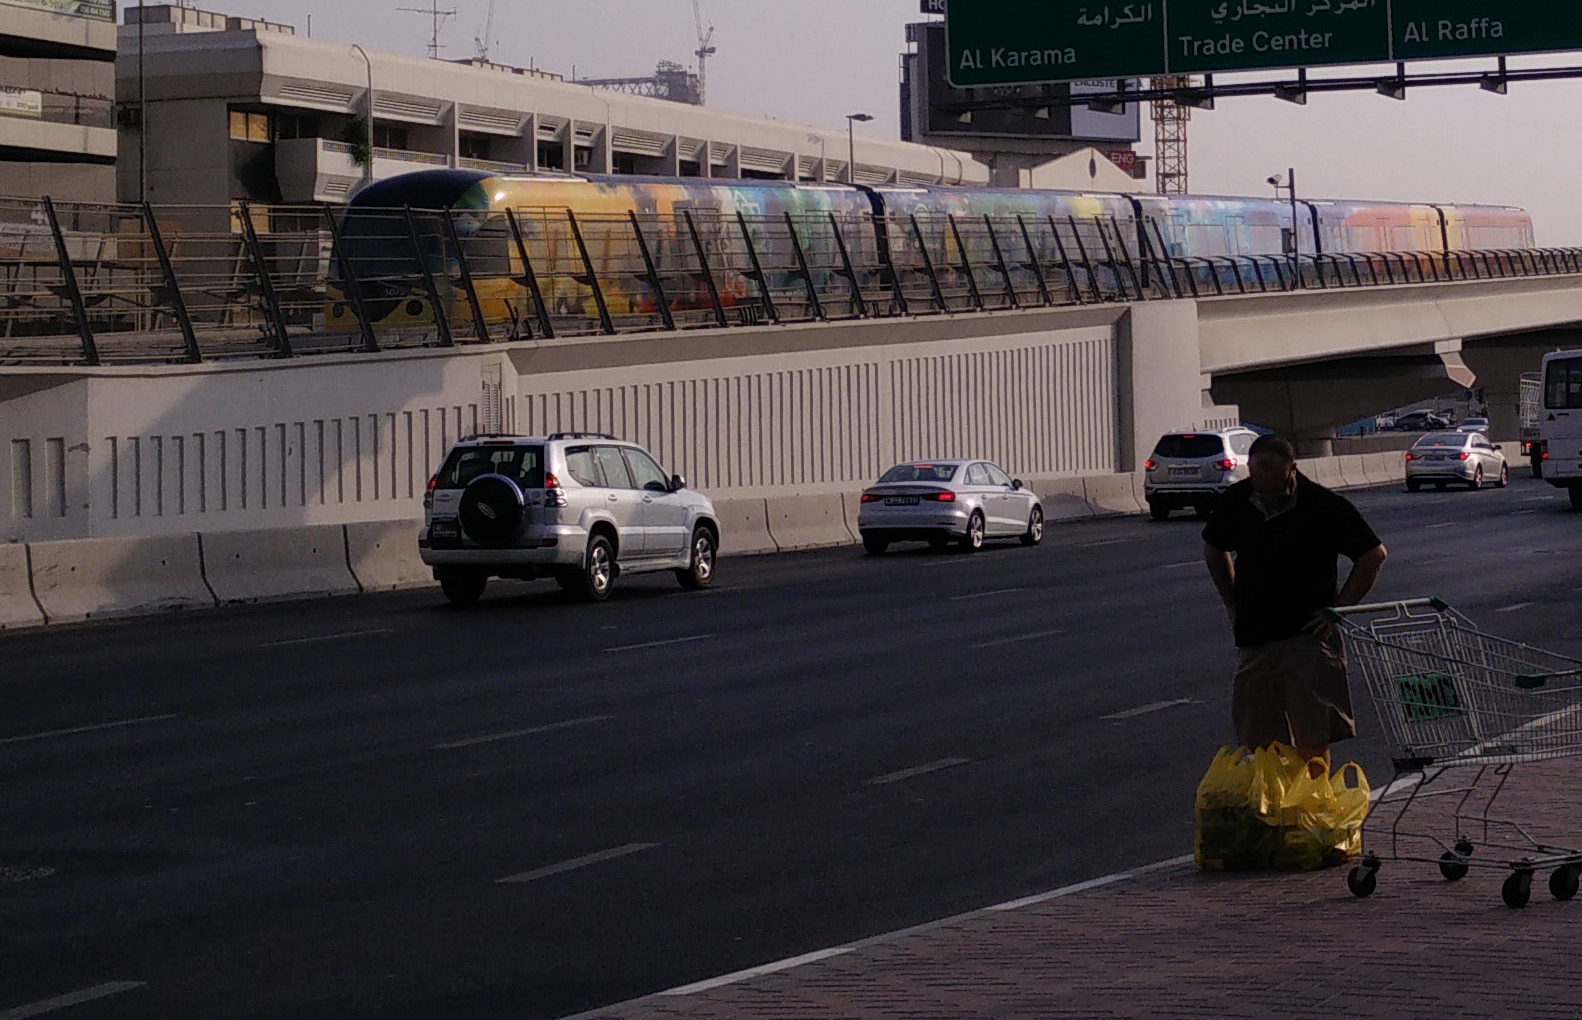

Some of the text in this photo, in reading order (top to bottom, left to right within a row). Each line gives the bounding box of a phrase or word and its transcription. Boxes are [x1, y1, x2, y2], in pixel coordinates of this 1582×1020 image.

[1076, 2, 1153, 29] الكرامة
[1178, 28, 1333, 57] Trade Center
[1403, 17, 1504, 44] Al Raffa
[959, 46, 1077, 70] Al Karama
